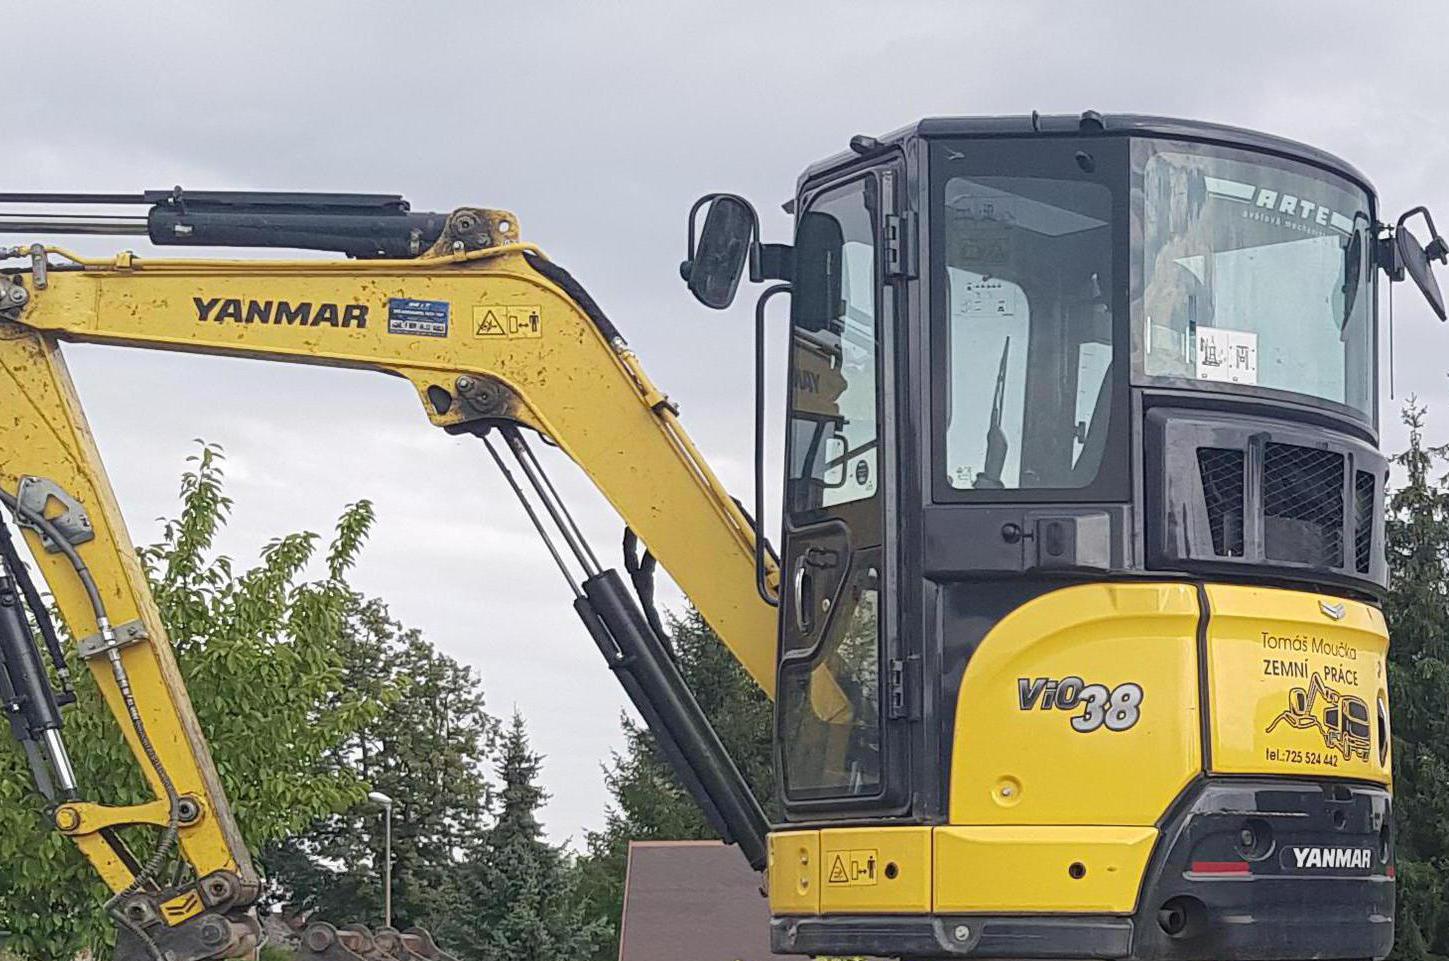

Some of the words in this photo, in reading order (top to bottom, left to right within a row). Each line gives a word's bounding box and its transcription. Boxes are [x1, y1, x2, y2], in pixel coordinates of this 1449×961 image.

[193, 297, 369, 329] YANMAR
[1261, 632, 1308, 652] Tomáš
[1312, 637, 1357, 660] Moučka
[1263, 658, 1308, 679] ZEMNÍ
[1323, 664, 1359, 686] PRÁCE
[1305, 751, 1321, 765] 524
[1323, 753, 1338, 767] 442
[1293, 847, 1371, 869] YANMAR
